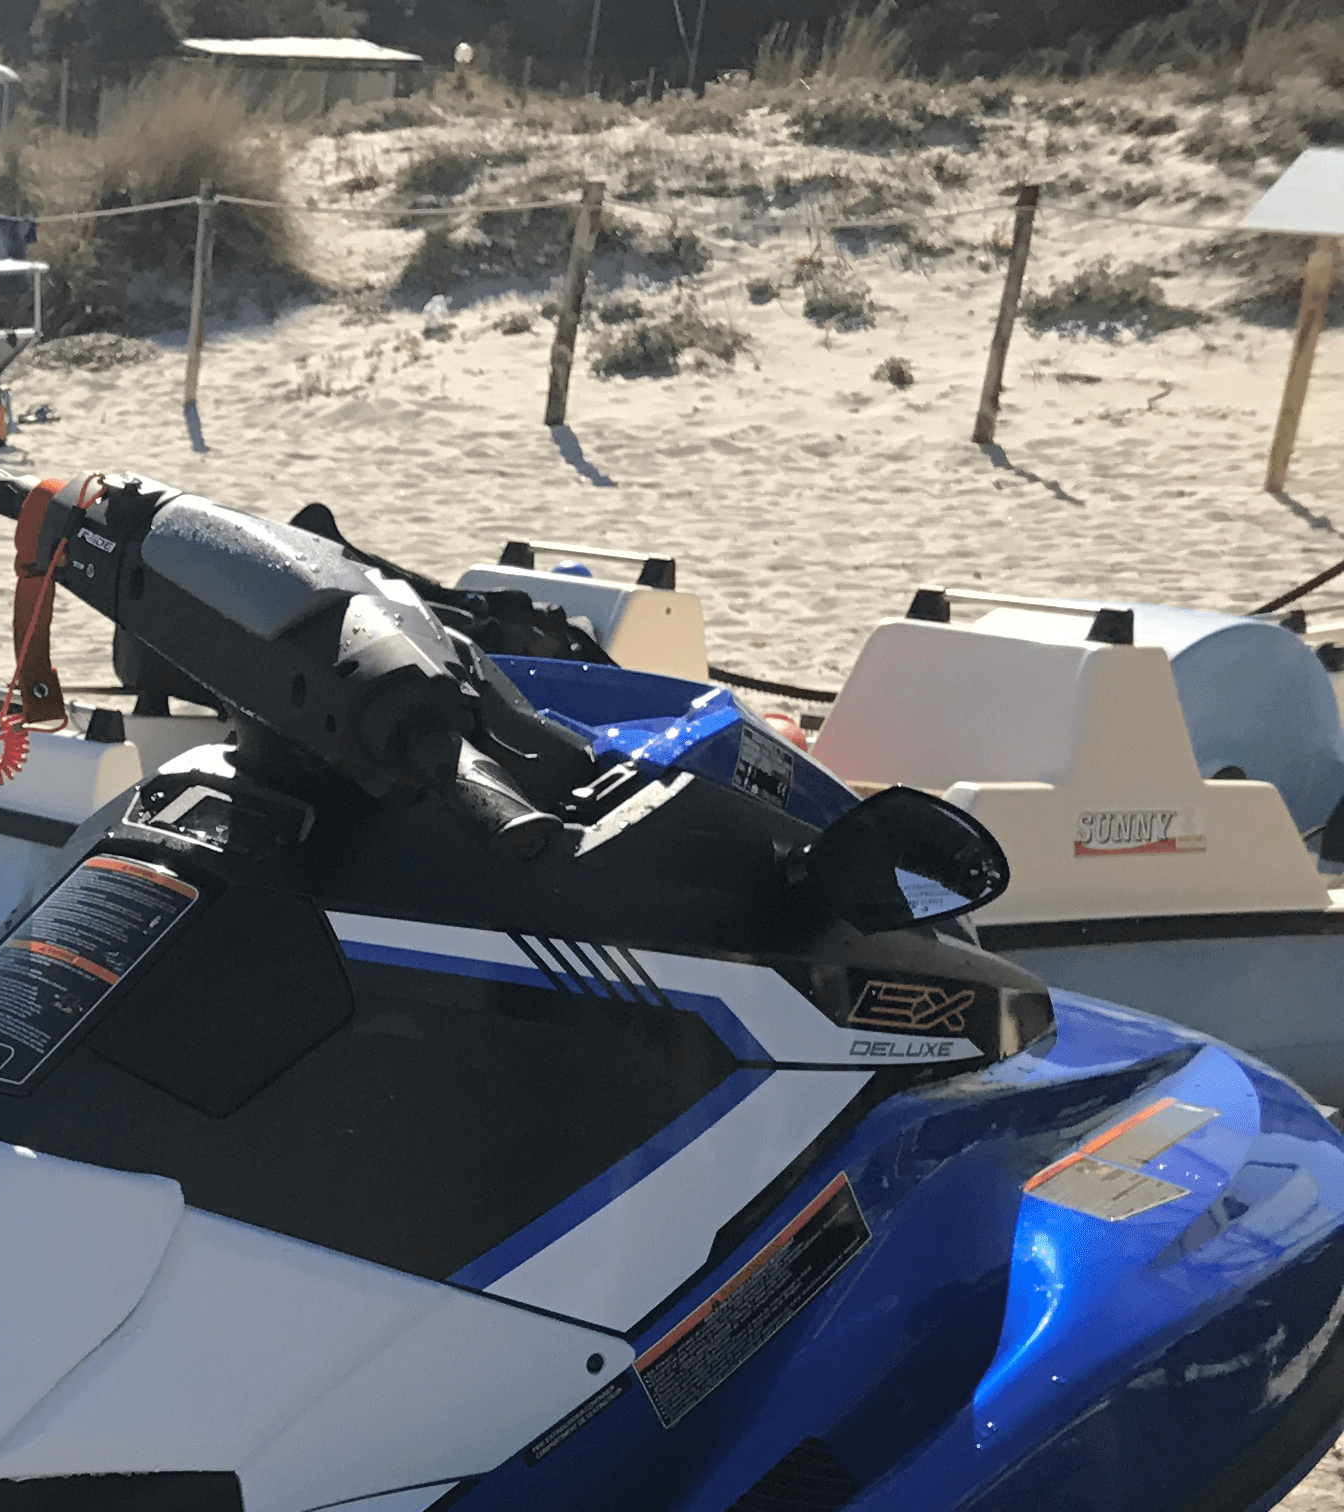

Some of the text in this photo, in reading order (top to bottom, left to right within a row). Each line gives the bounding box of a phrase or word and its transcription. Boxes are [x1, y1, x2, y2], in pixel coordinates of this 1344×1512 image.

[1076, 810, 1177, 844] SUNNY
[847, 980, 976, 1032] EX
[849, 1040, 954, 1057] DELUXE
